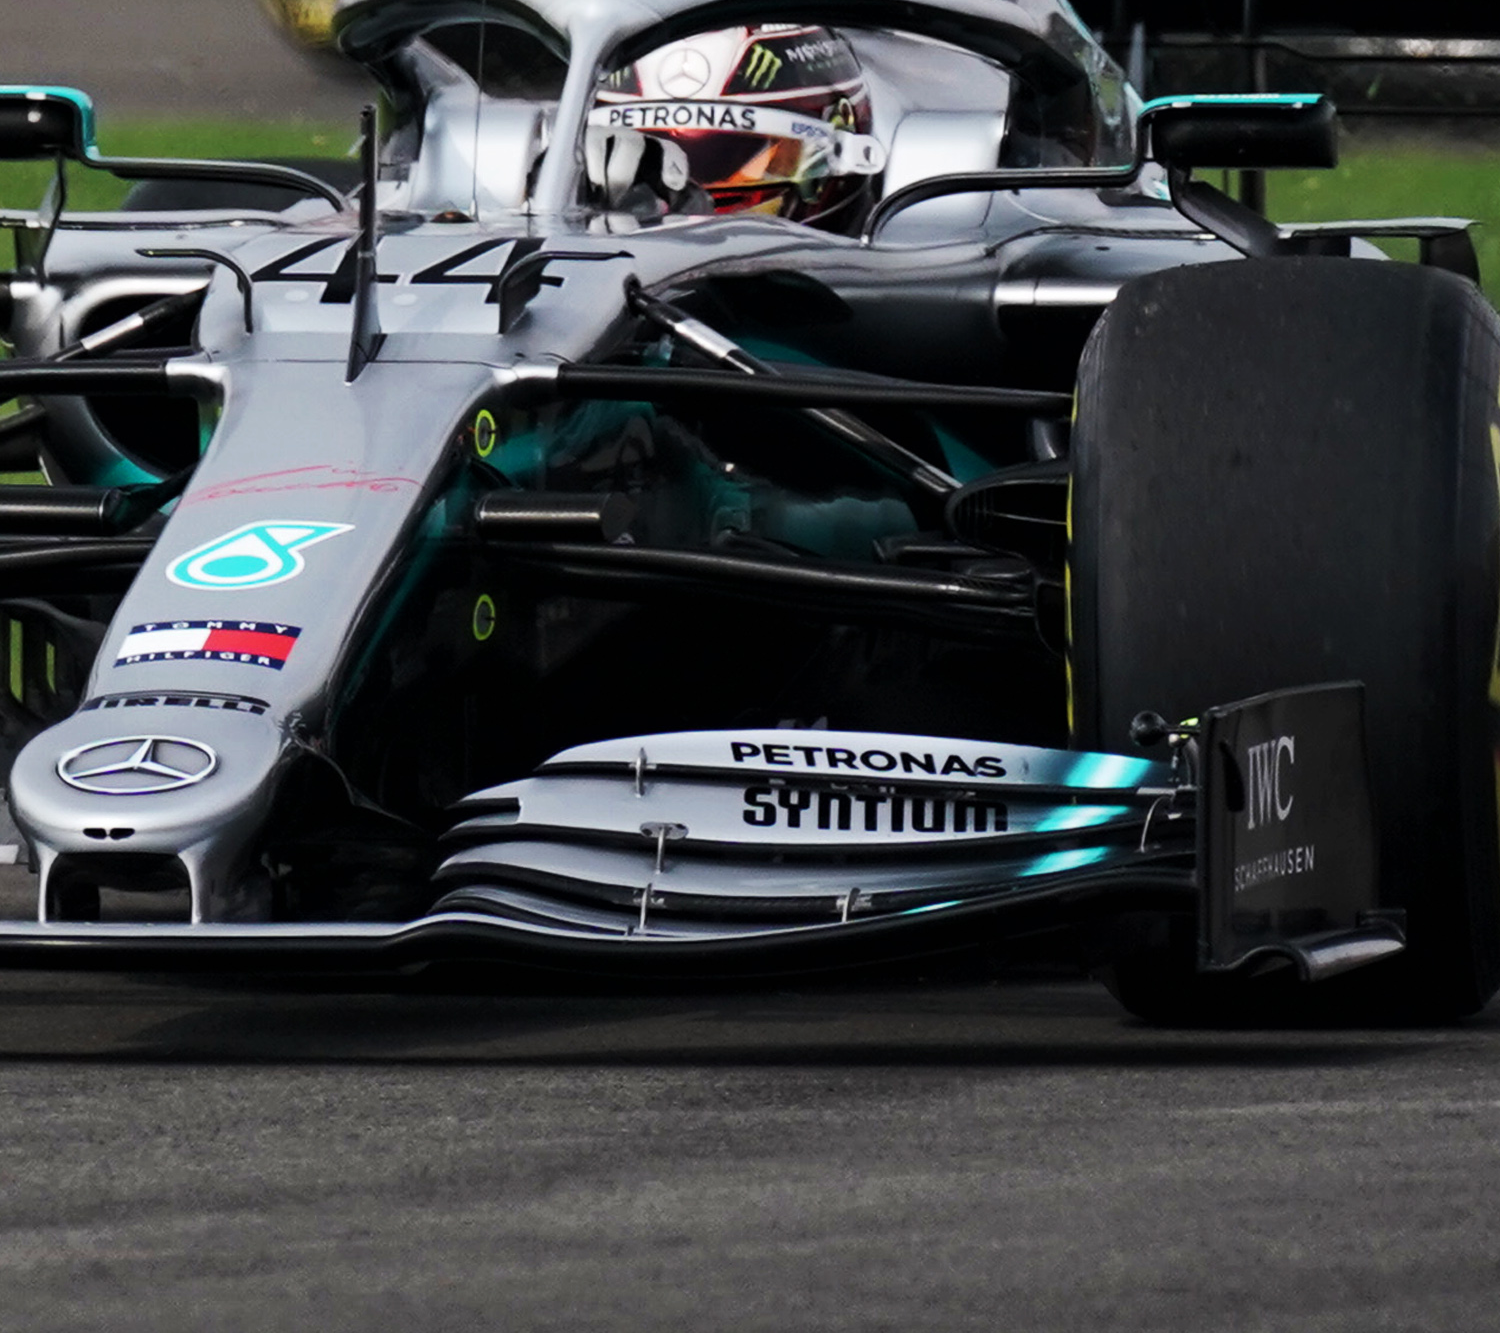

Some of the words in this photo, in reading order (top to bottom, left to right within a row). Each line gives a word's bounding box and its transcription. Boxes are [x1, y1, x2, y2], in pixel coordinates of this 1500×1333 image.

[609, 103, 756, 133] PETRONAS
[249, 235, 567, 306] 44
[142, 619, 291, 635] TOMMY
[124, 649, 273, 668] HILFIGER
[730, 741, 1008, 778] PETRONAS
[1247, 735, 1296, 831] IWC
